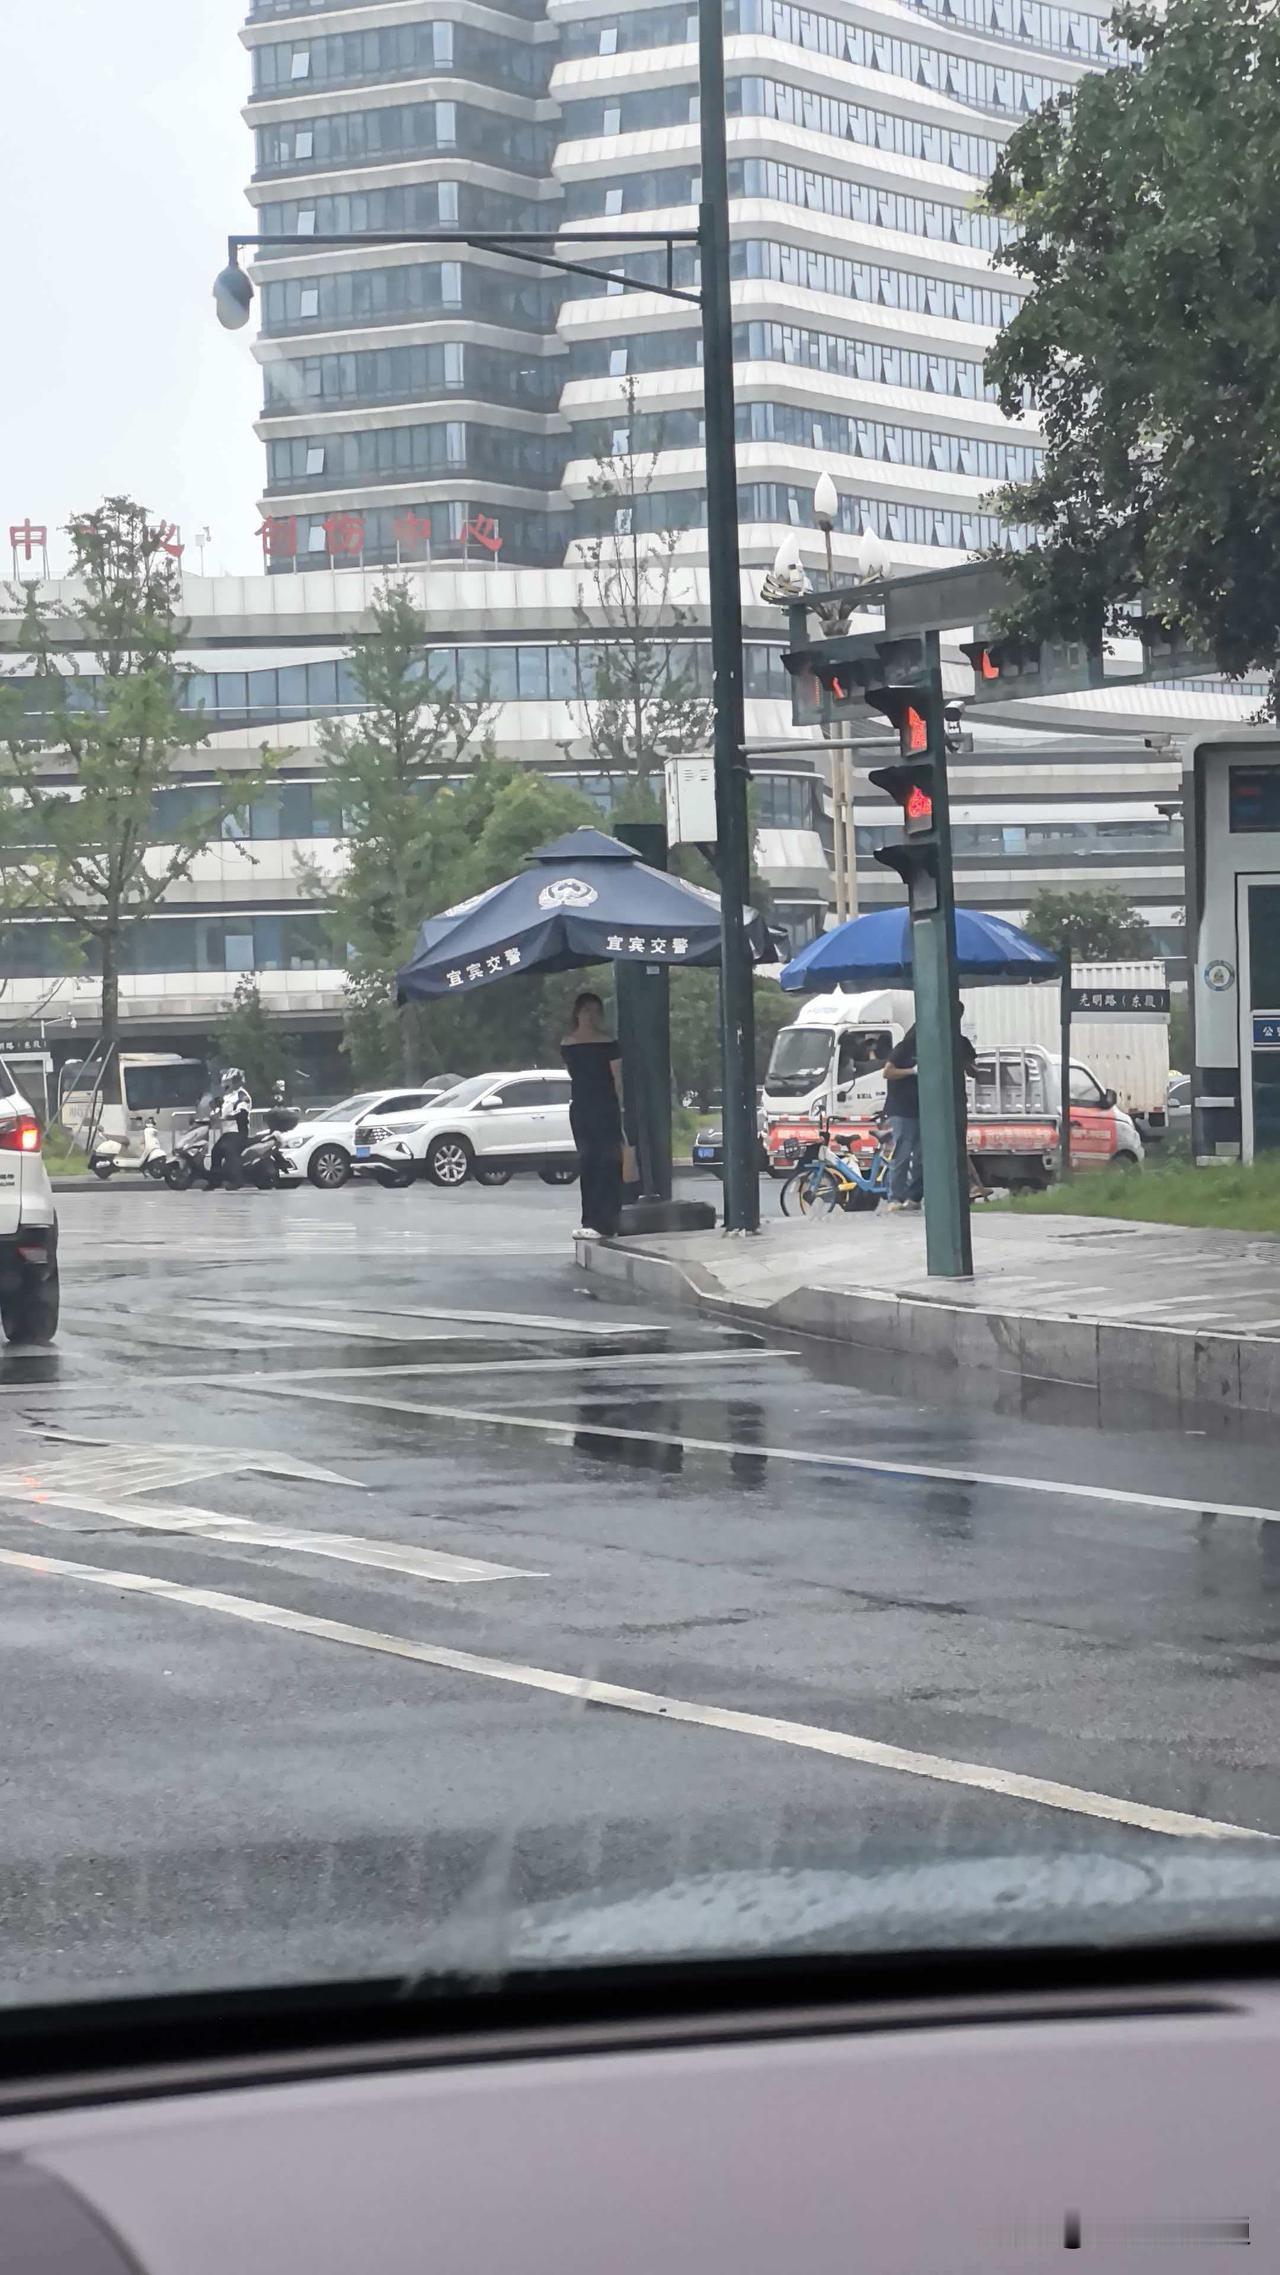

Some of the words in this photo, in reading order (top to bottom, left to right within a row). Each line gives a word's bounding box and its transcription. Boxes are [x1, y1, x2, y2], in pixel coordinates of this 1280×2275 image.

[606, 935, 689, 954] 宜宾交警
[446, 947, 521, 987] 宜宾交警
